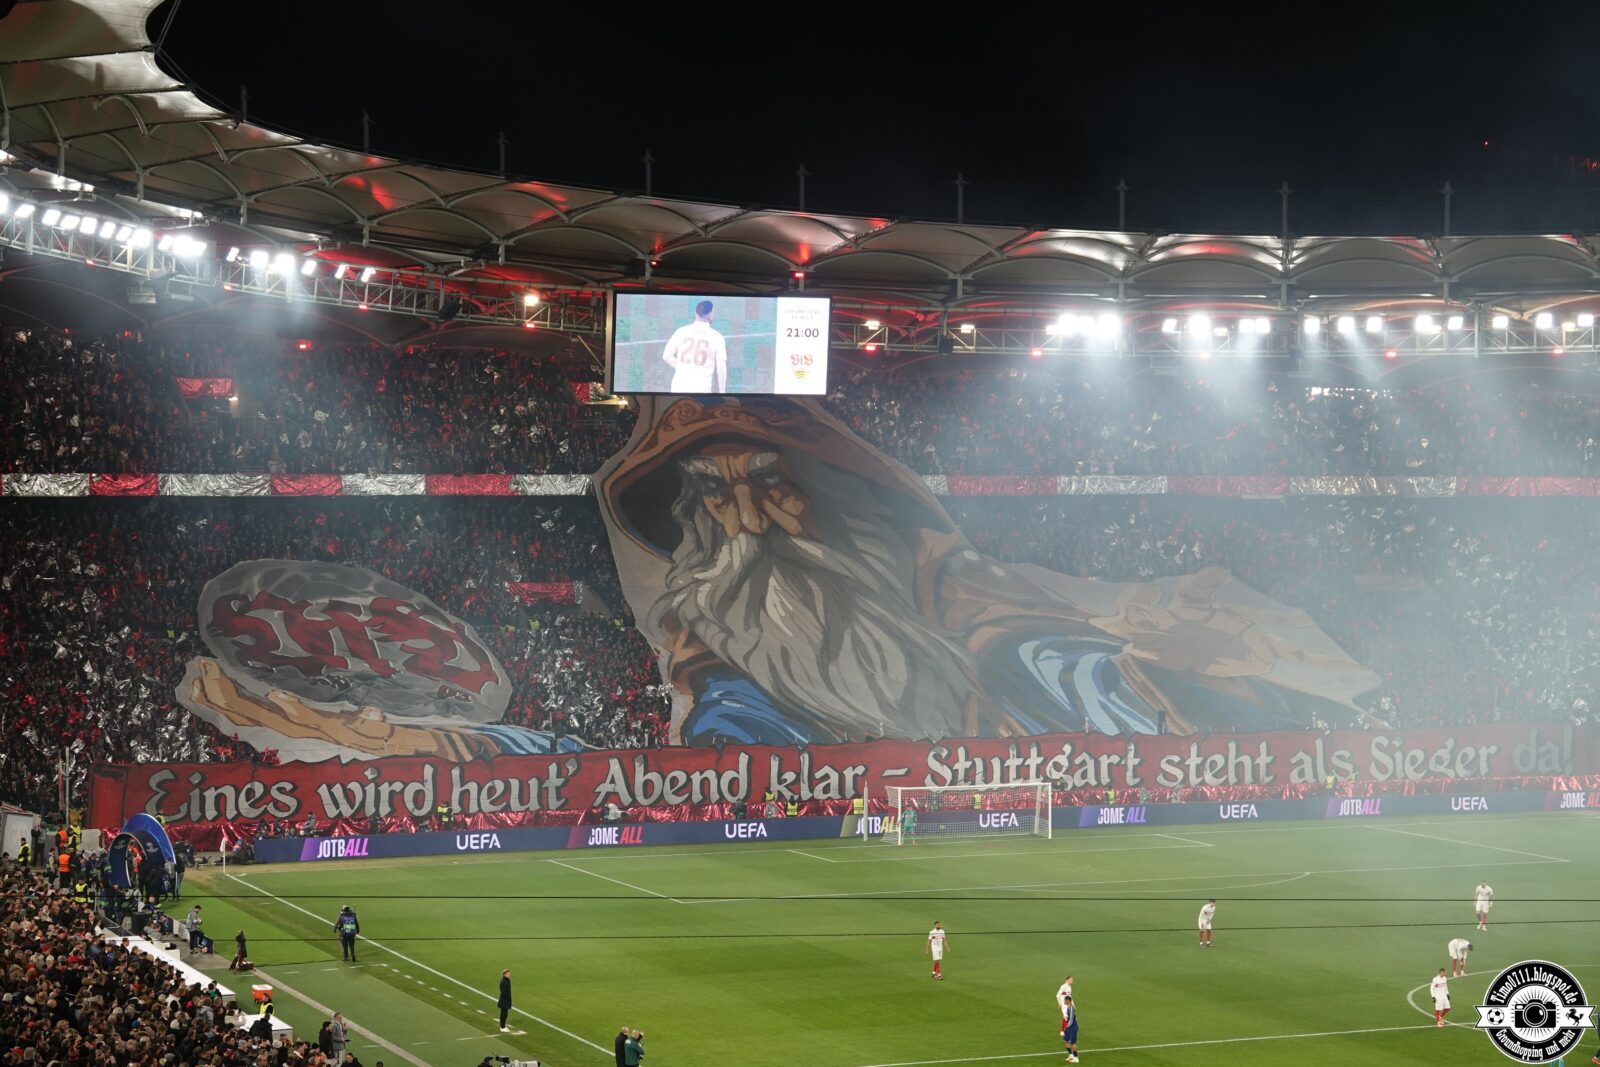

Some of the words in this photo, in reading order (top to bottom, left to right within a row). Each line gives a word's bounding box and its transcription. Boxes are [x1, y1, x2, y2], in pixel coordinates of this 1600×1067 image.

[786, 327, 819, 338] 21:00
[680, 336, 709, 366] 26
[147, 769, 298, 822] Eines
[317, 764, 434, 818] wird
[593, 752, 749, 807] Abend
[770, 752, 866, 802] klar
[923, 740, 1141, 792] Stuttgart
[1156, 739, 1274, 787] steht
[1289, 737, 1354, 784] als
[1369, 735, 1497, 780] Sieger
[1512, 726, 1575, 774] da!
[1219, 804, 1258, 819] UEFA
[1451, 796, 1488, 811] UEFA
[979, 813, 1019, 828] UEFA
[1125, 806, 1146, 823] ALL
[620, 826, 643, 844] ALL
[725, 822, 767, 838] UEFA
[456, 833, 501, 850] UEFA
